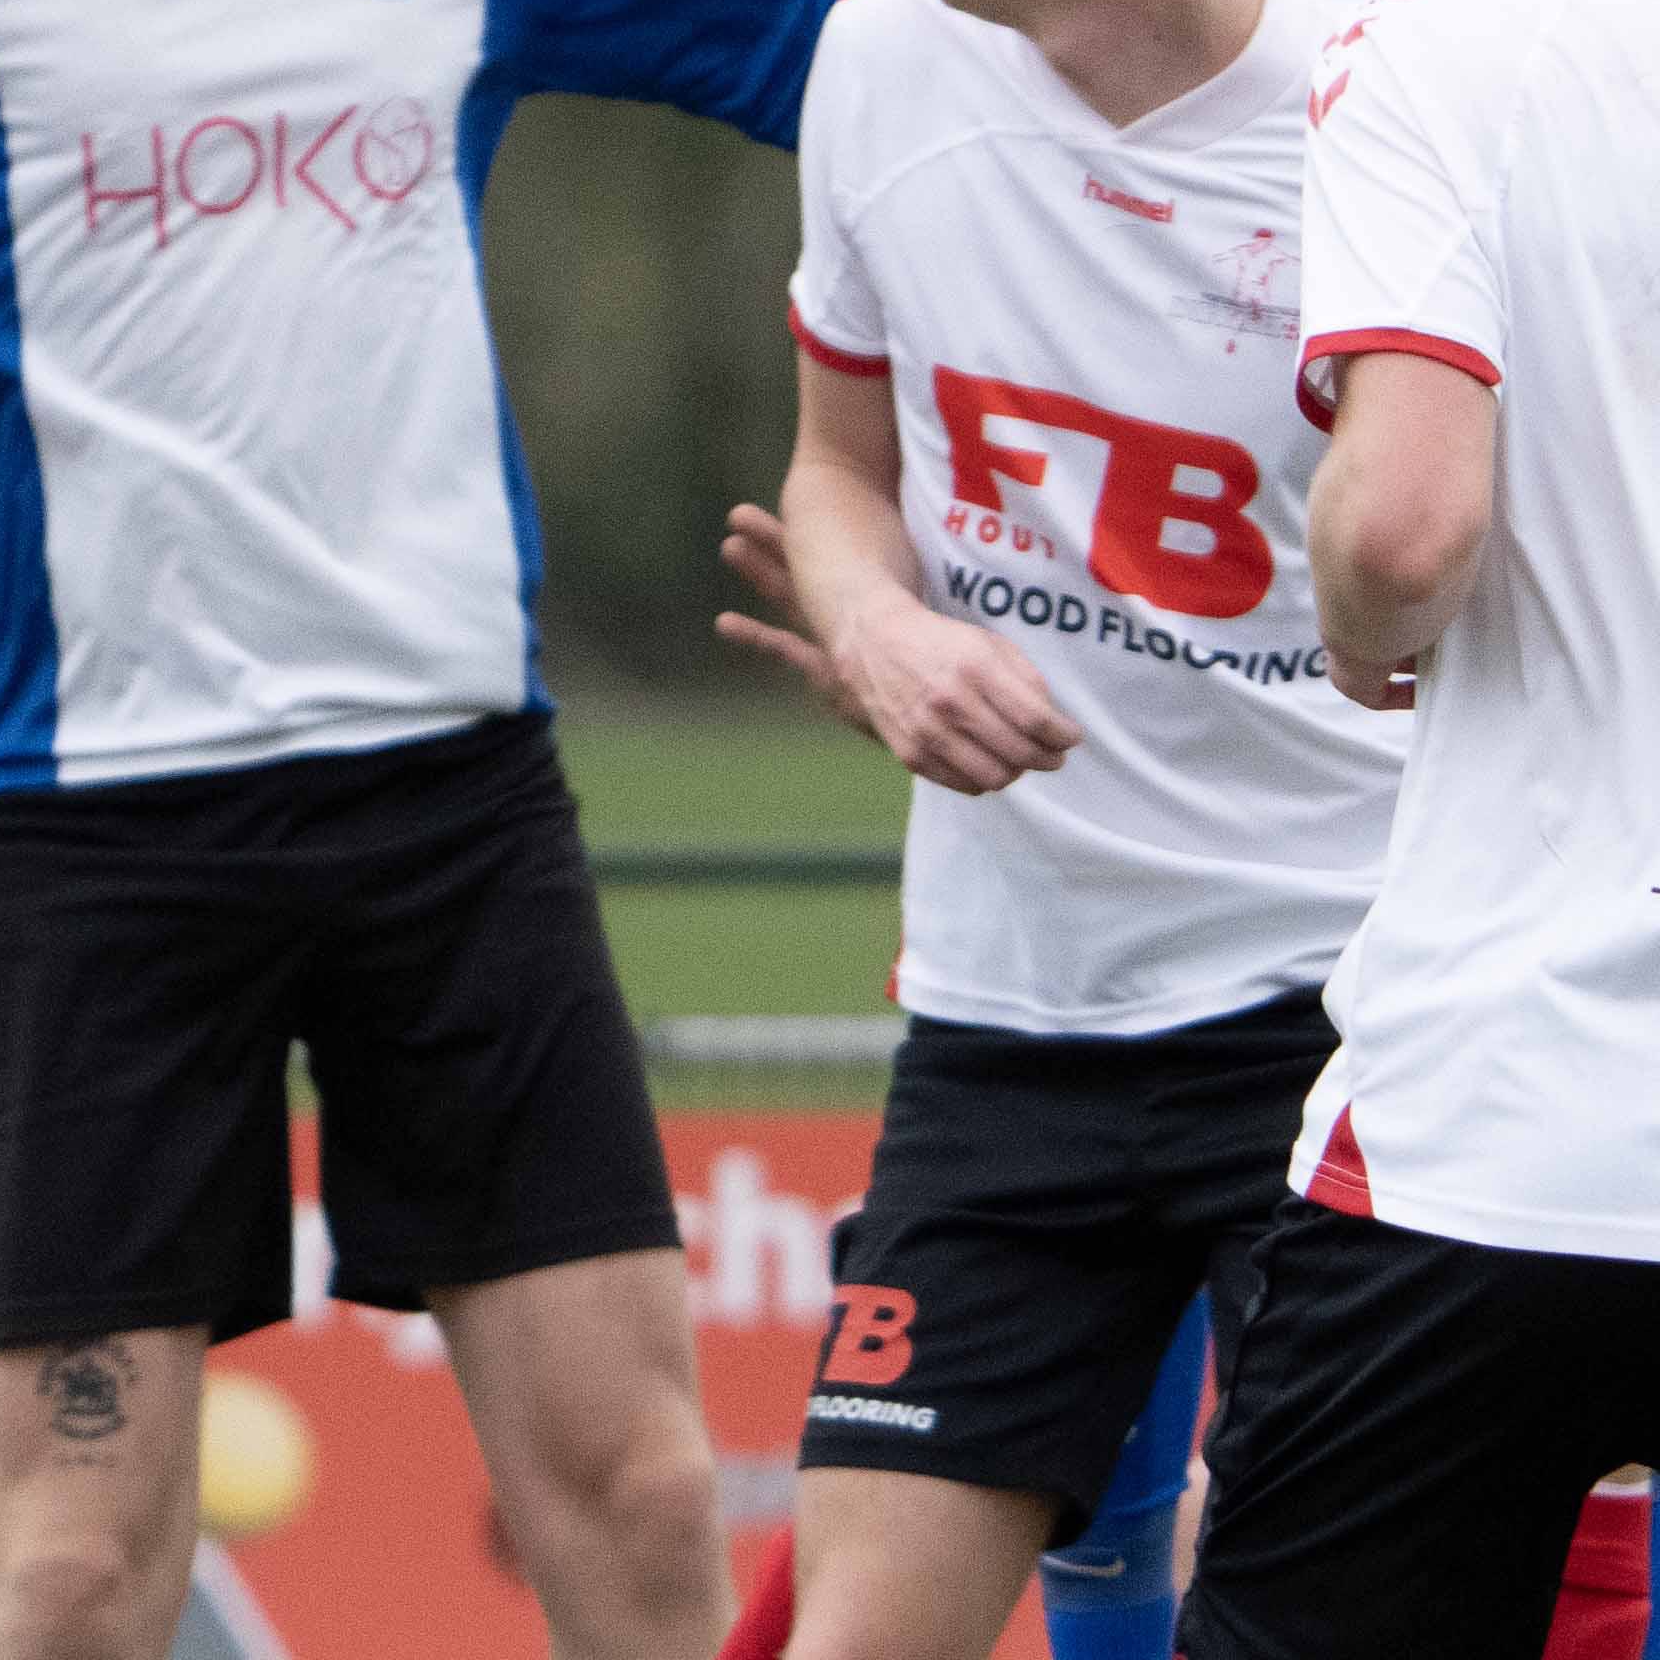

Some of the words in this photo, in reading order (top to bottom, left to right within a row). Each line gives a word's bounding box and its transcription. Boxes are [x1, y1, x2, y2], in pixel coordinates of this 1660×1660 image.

[80, 98, 434, 249] HOKO
[933, 362, 1276, 619] FB
[943, 557, 1089, 633] WOOD
[807, 1395, 936, 1431] OORING
